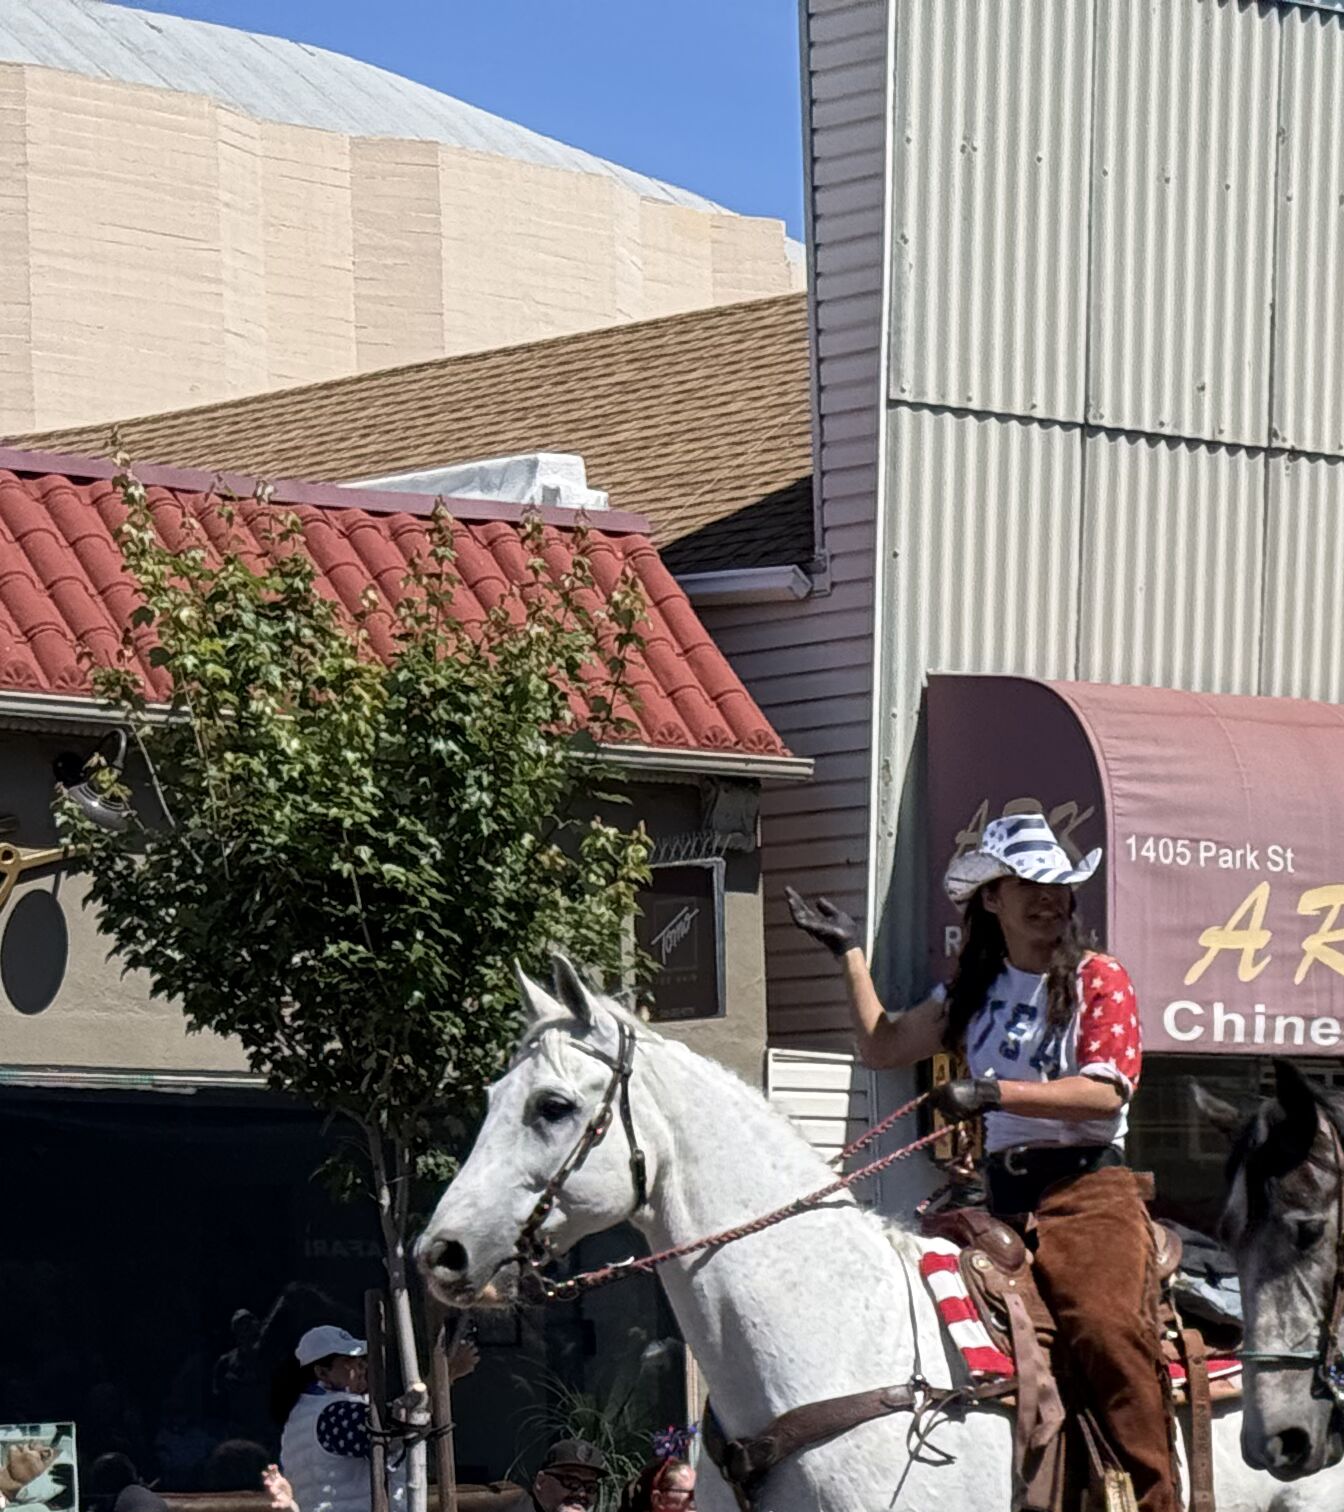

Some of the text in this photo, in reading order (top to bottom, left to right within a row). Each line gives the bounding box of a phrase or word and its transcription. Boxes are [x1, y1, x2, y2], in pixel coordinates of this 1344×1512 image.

[1125, 834, 1296, 874] 1405 Park St
